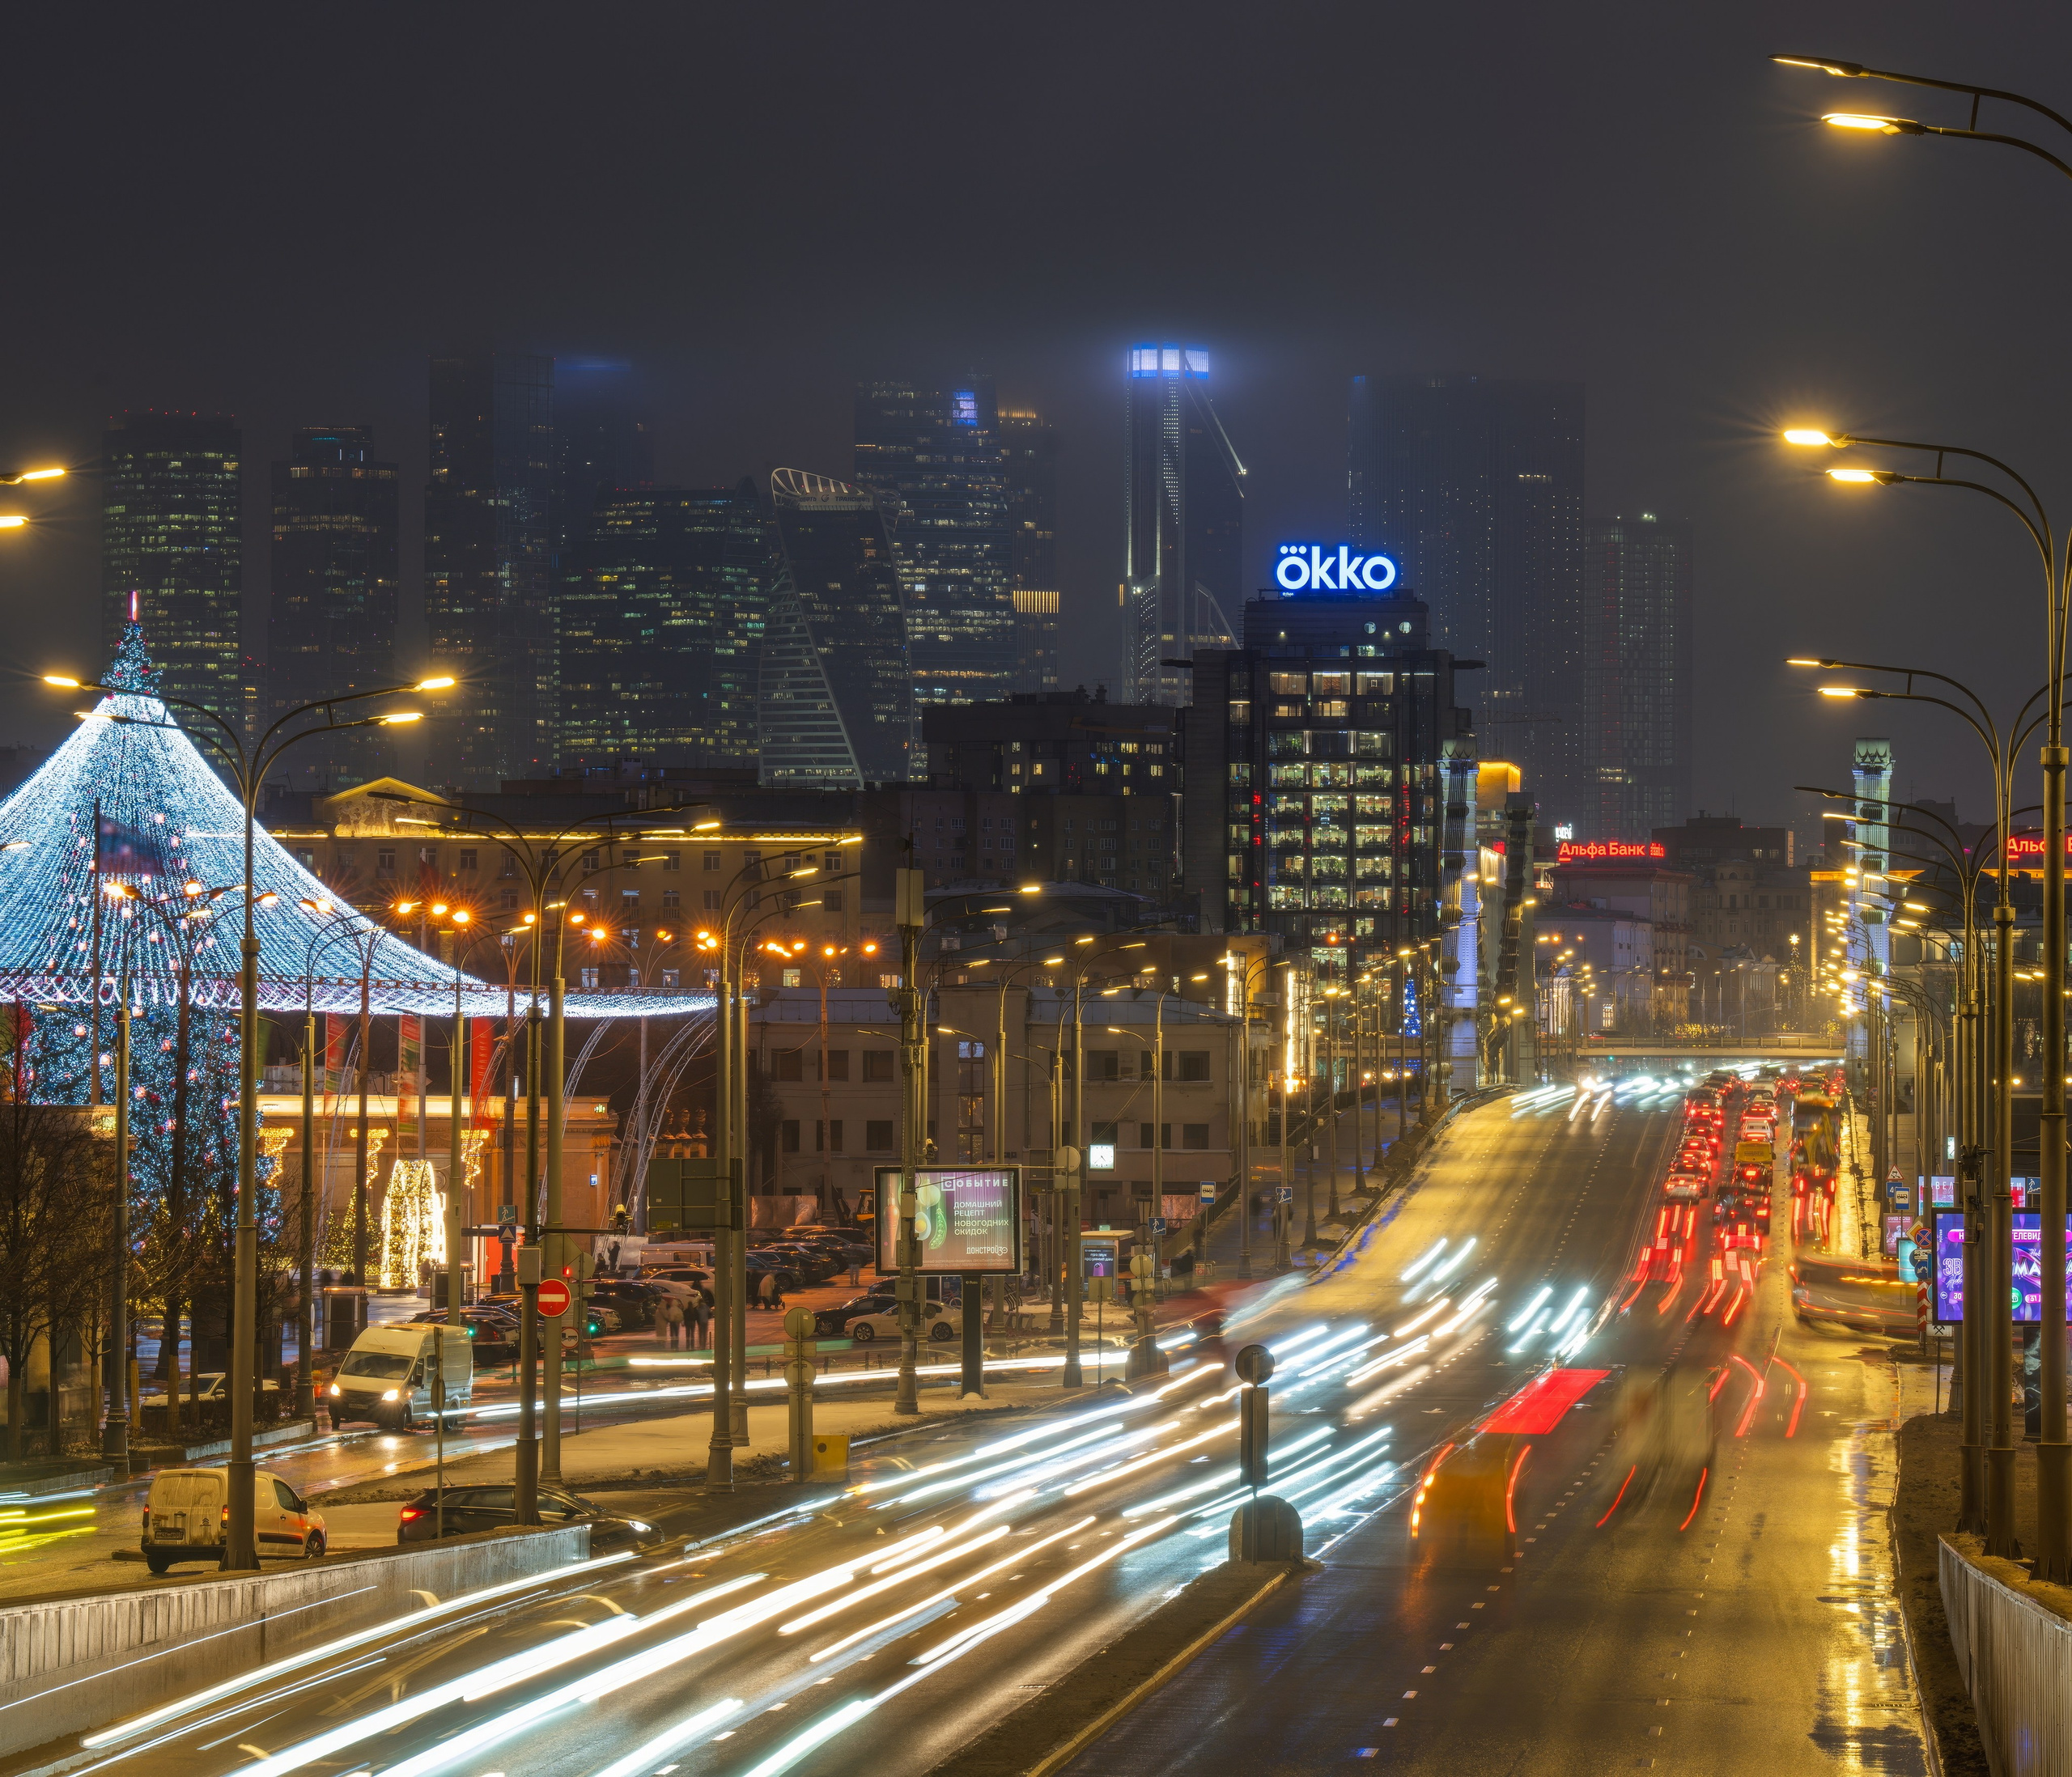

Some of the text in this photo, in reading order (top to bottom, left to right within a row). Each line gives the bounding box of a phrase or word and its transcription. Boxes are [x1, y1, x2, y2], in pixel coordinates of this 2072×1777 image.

[2008, 837, 2044, 853] Аль
[1559, 842, 1645, 859] Альфа Банк
[942, 1177, 1008, 1190] СОБЫТИЕ
[953, 1200, 1003, 1209] ДОМАШНИЙ
[954, 1209, 985, 1217] РЕЦЕПТ
[954, 1219, 1009, 1228] НОВОГОДНИХ
[954, 1228, 988, 1236] СКИДОК
[966, 1245, 999, 1254] ДОНСТРОЙ
